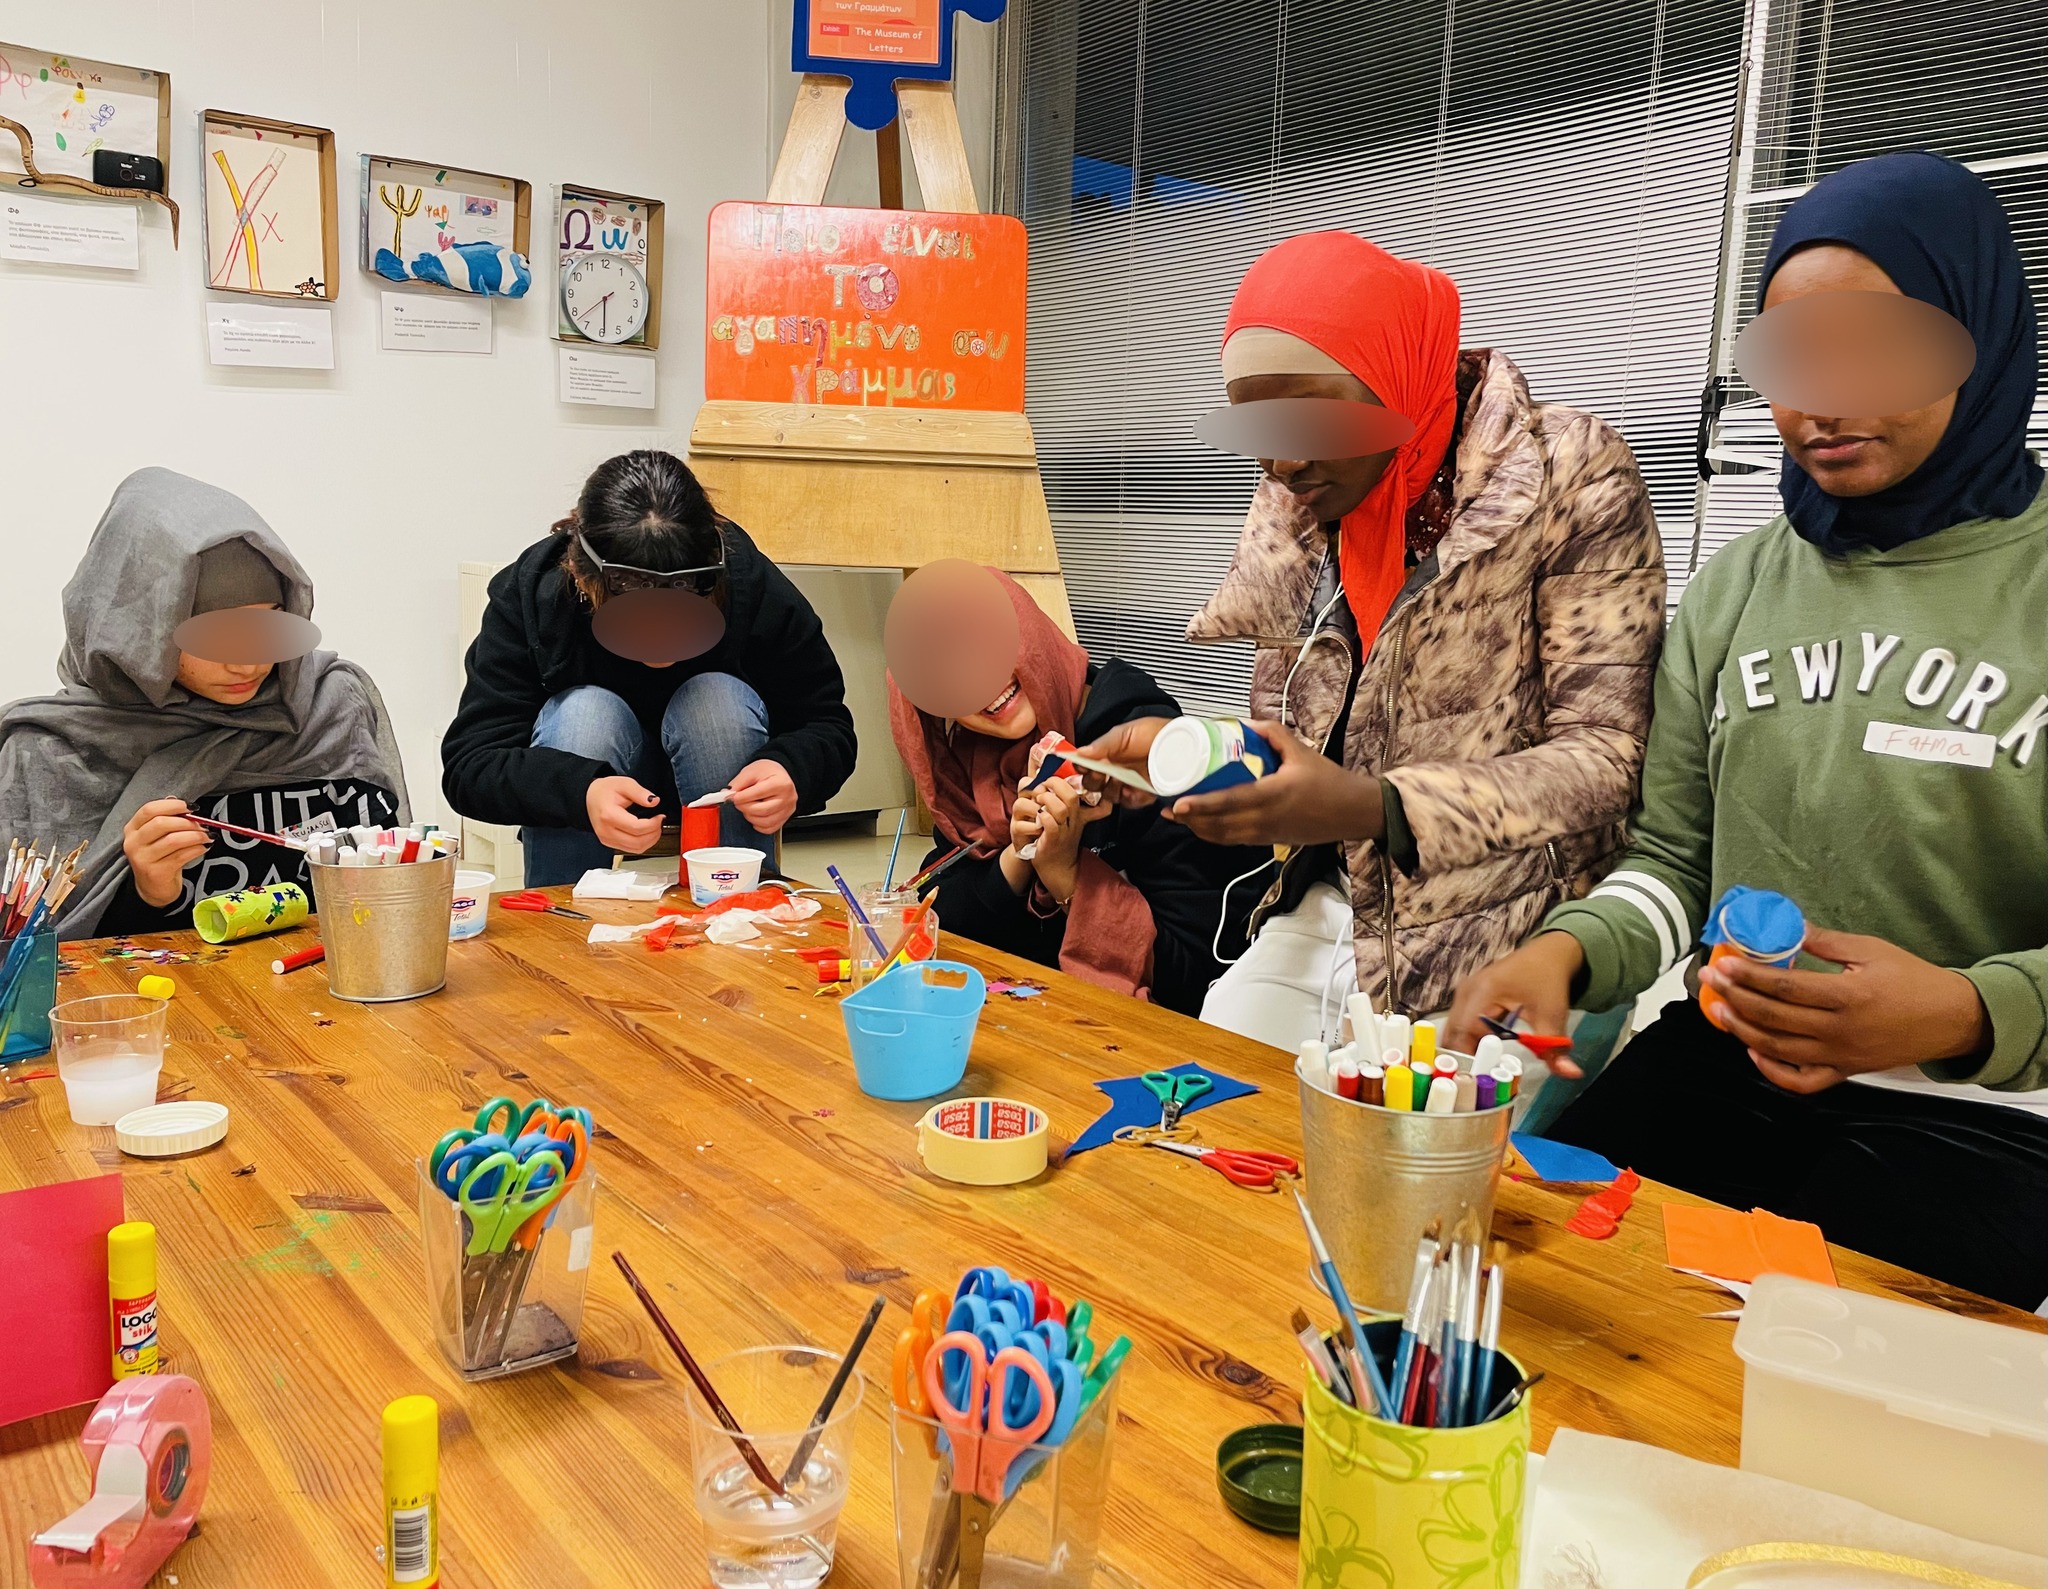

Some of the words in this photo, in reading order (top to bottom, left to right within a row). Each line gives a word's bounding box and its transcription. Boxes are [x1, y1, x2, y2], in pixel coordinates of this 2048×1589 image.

[855, 2, 902, 13] Γραμμάτων
[855, 27, 872, 36] The
[874, 29, 910, 39] Museum
[912, 31, 923, 40] of
[869, 43, 903, 53] Letters
[752, 205, 840, 258] Ποιο
[883, 215, 975, 259] είναι
[585, 262, 594, 272] 11
[601, 259, 610, 269] 12
[573, 272, 582, 282] 10
[629, 281, 636, 290] 2
[568, 289, 574, 298] 9
[633, 299, 639, 308] 3
[571, 307, 578, 316] 8
[627, 316, 633, 324] 4
[584, 321, 590, 330] 7
[615, 326, 621, 335] 5
[711, 312, 921, 367] αγαπημένο
[952, 329, 1009, 360] σου
[1885, 729, 1971, 758] Fatma
[944, 1111, 970, 1123] tesa
[132, 1324, 153, 1338] stik
